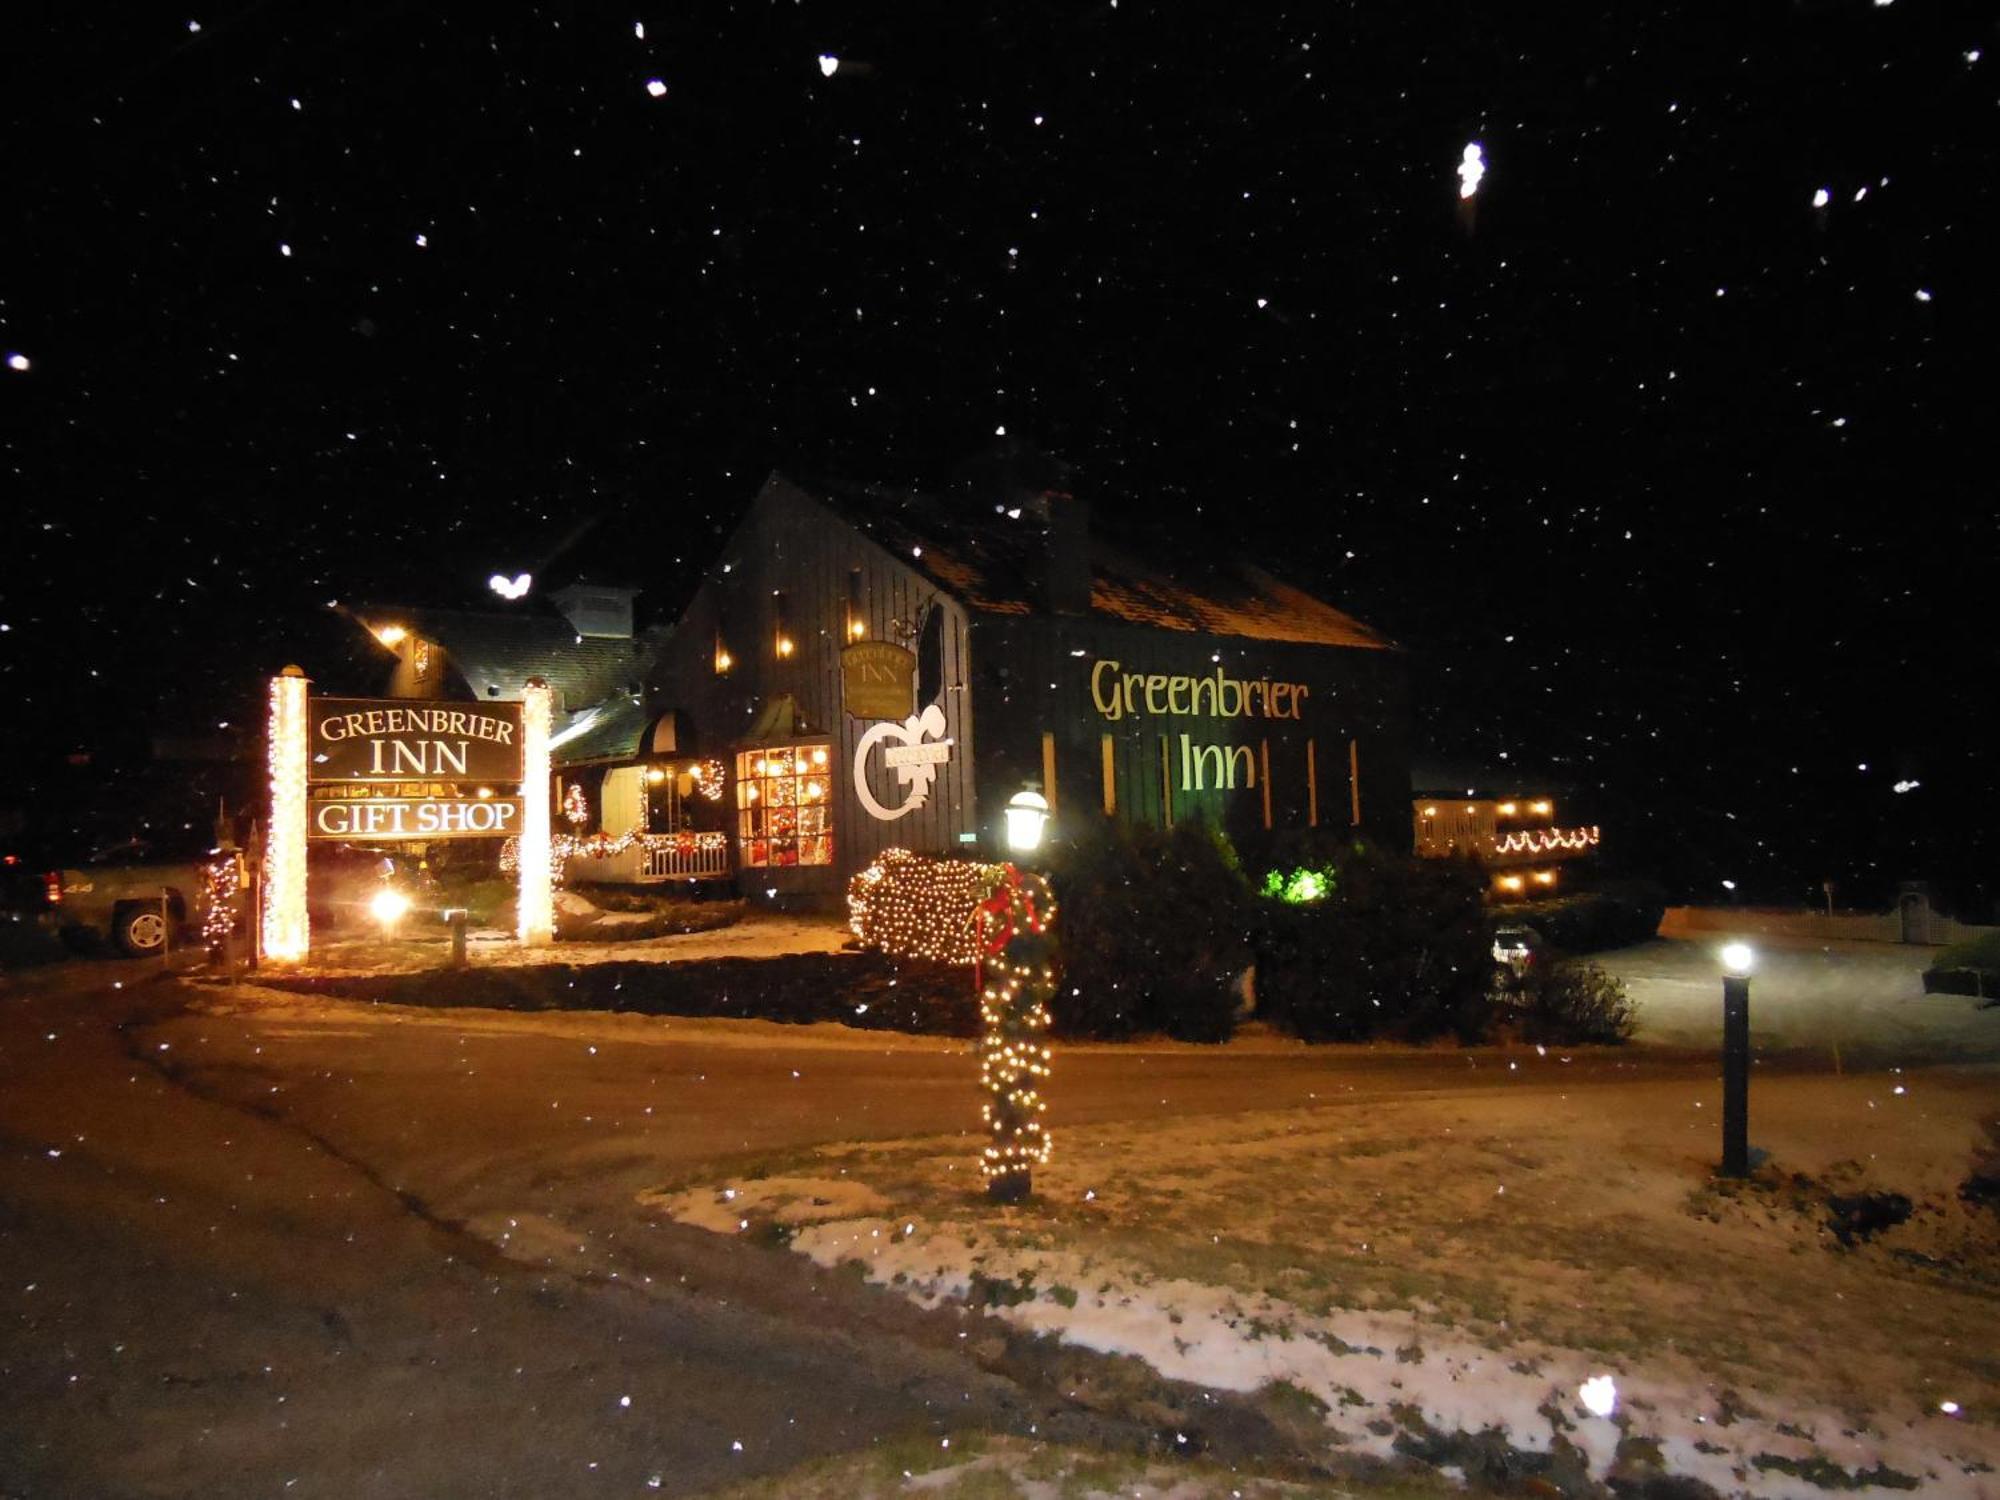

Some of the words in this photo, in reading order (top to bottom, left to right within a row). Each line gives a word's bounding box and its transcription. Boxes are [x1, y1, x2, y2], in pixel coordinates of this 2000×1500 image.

[1091, 660, 1309, 721] Greenbrier
[320, 709, 513, 745] GREENBRIER
[370, 740, 470, 774] INN
[1180, 734, 1256, 790] Inn
[317, 804, 410, 834] GIFT
[418, 803, 515, 832] SHOP
